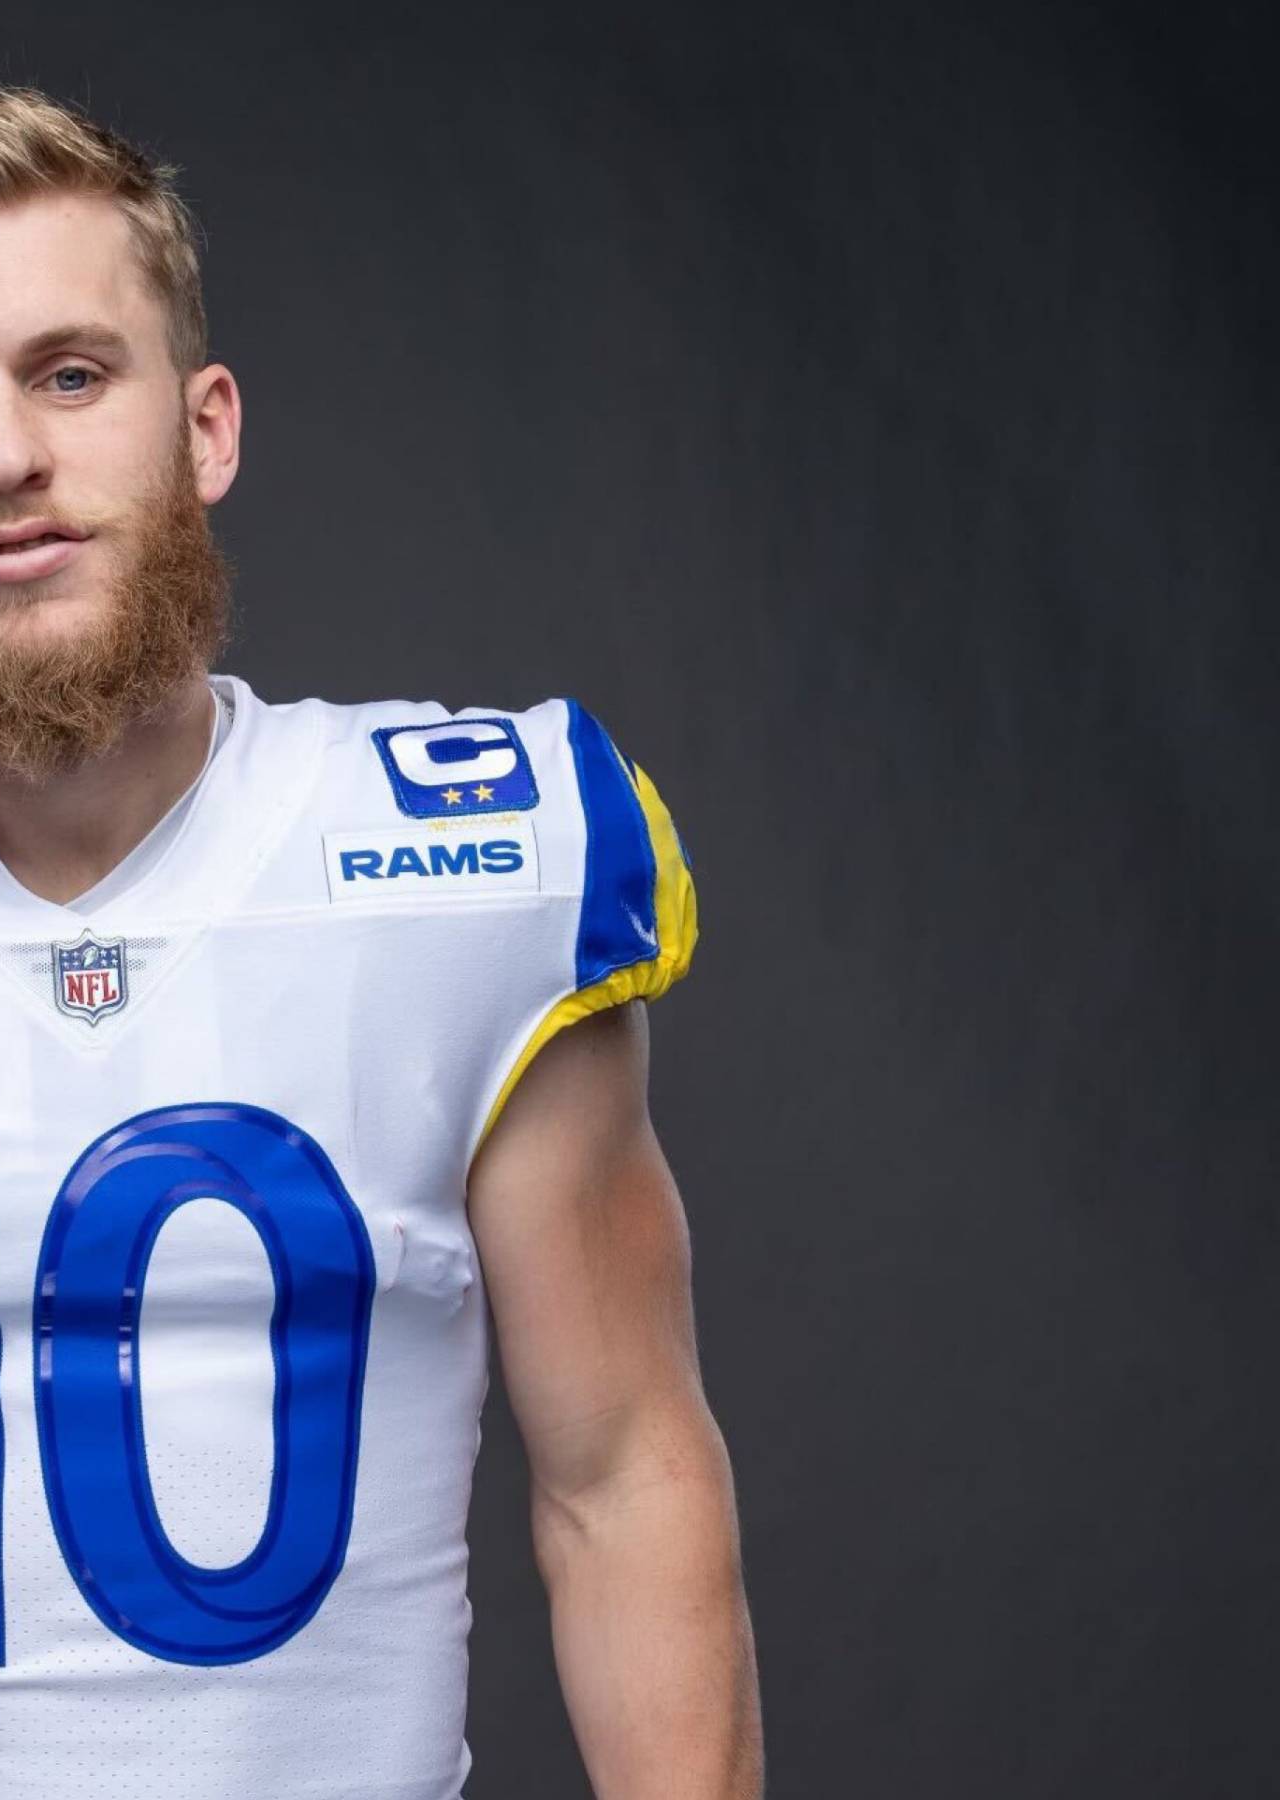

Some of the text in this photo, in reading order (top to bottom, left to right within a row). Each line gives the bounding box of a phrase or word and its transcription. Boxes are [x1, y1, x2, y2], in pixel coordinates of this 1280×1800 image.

[389, 723, 517, 786] C
[339, 839, 524, 881] RAMS
[65, 972, 118, 1007] NFL
